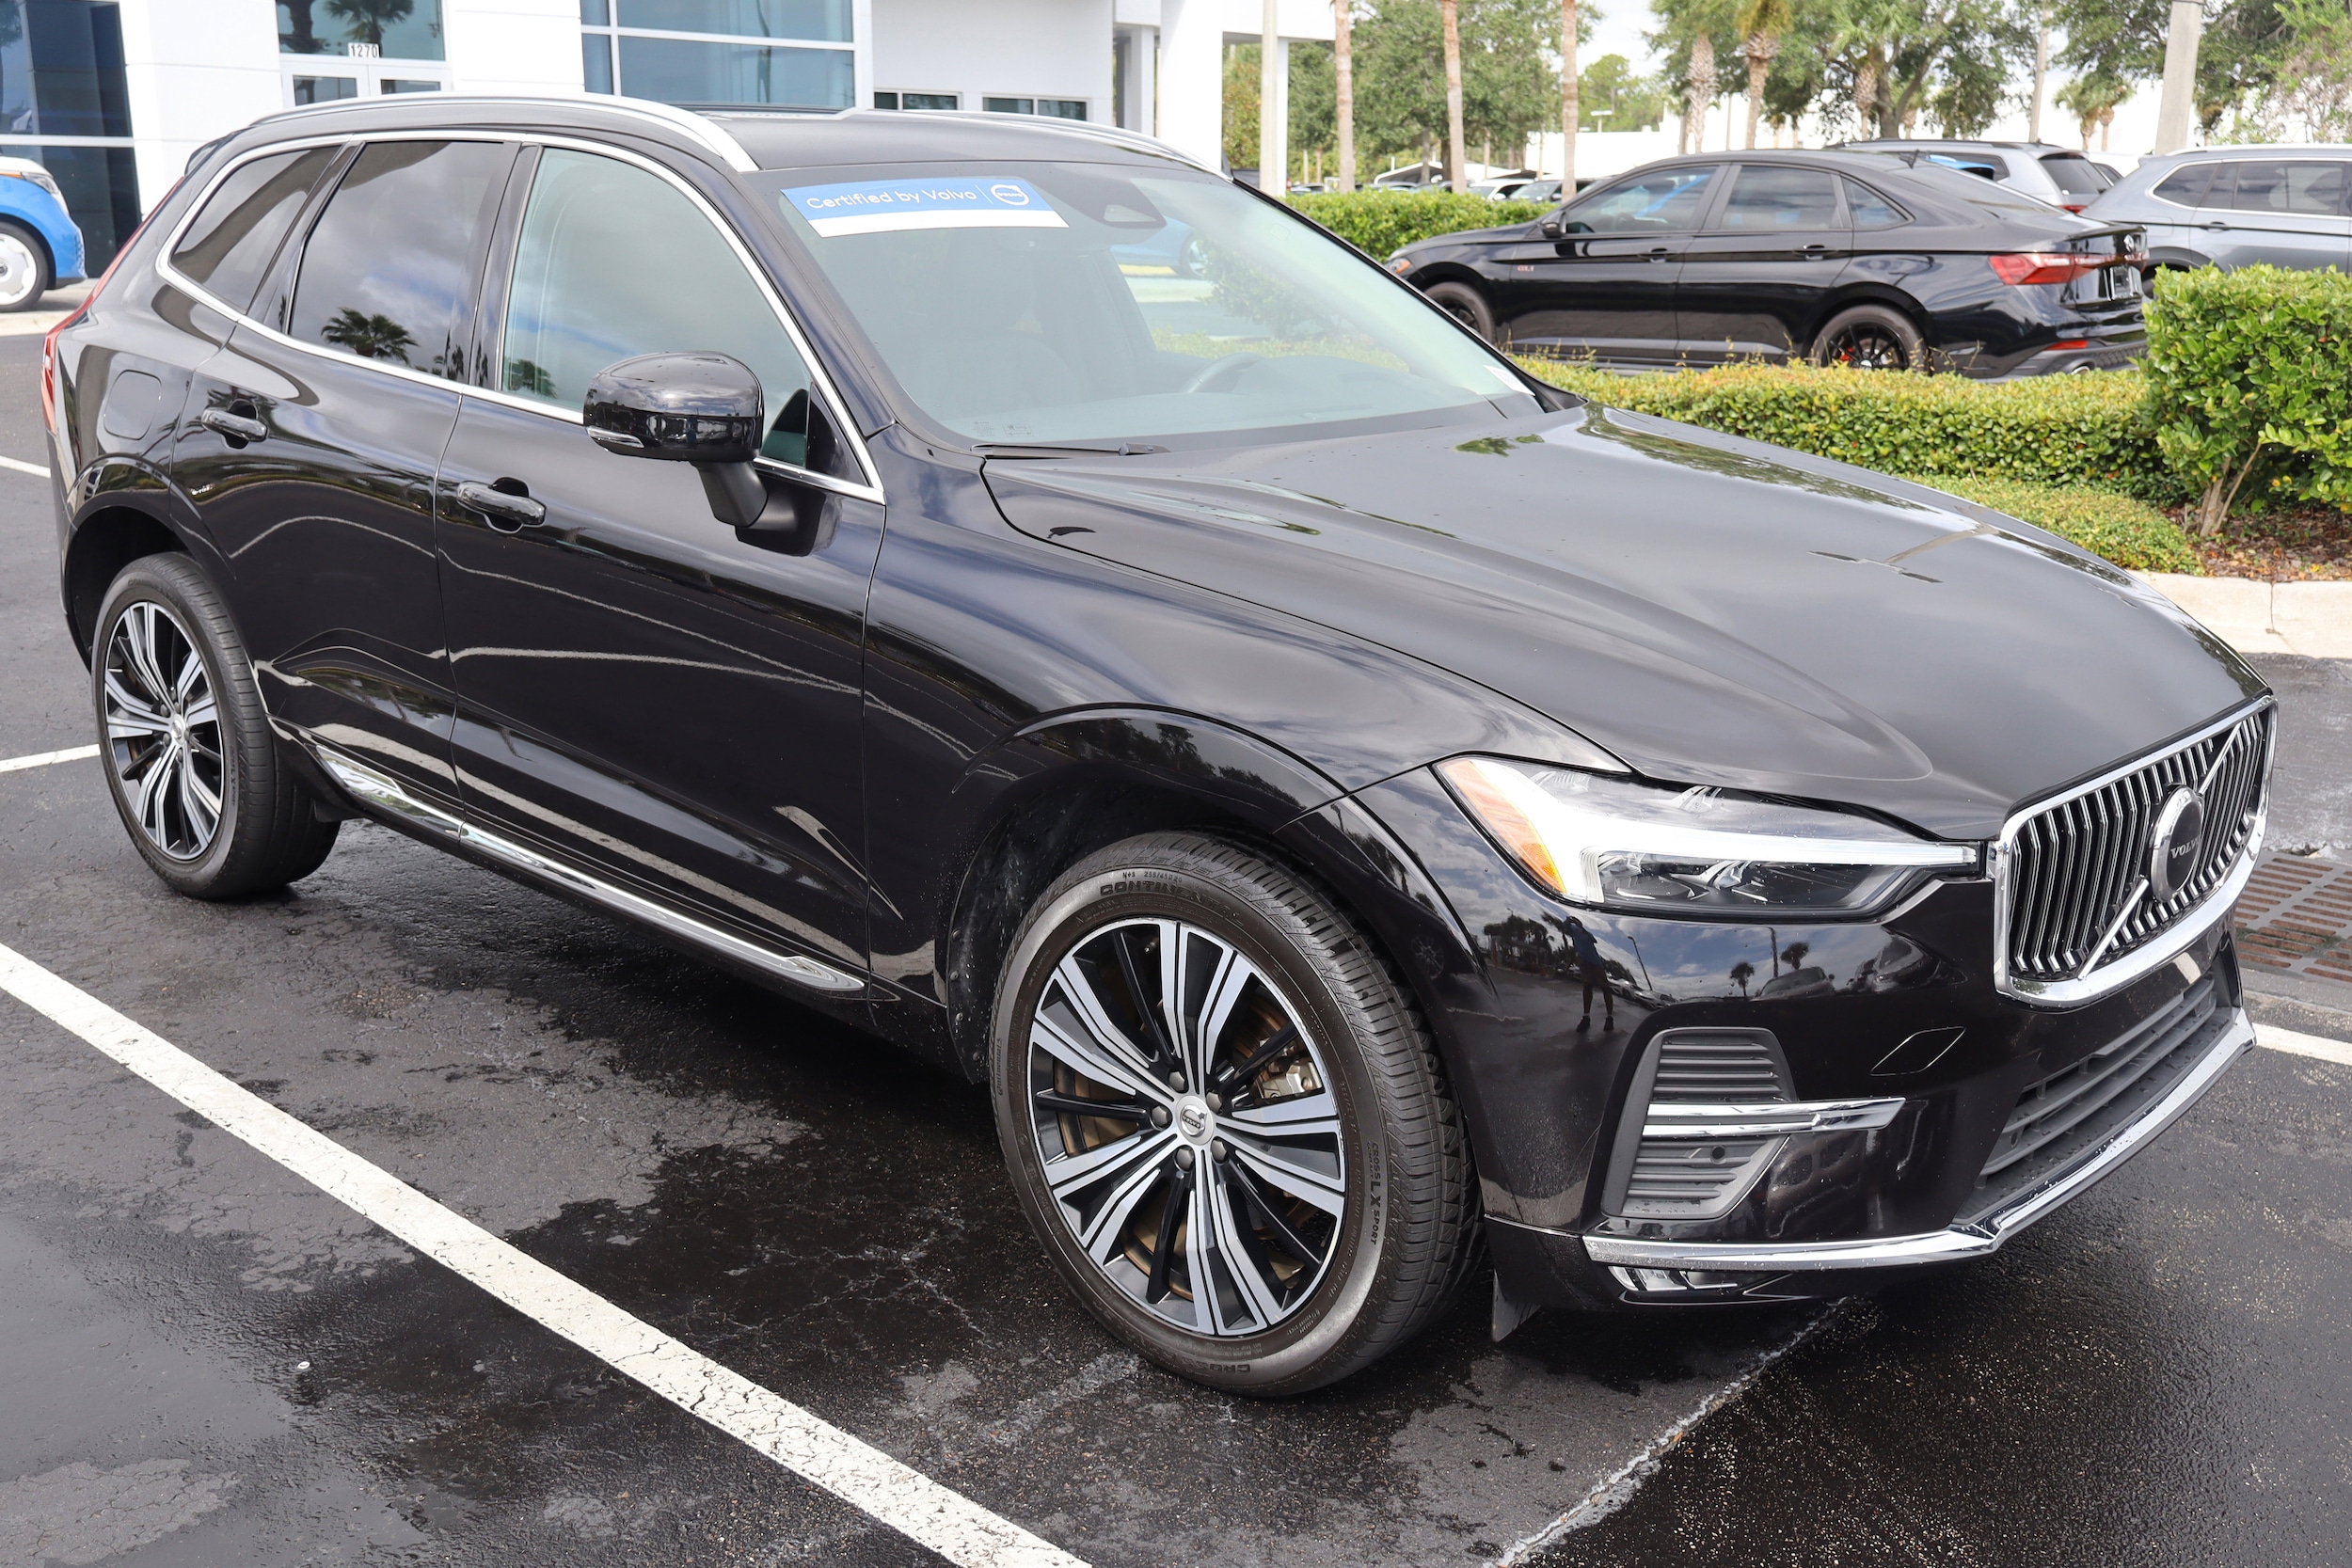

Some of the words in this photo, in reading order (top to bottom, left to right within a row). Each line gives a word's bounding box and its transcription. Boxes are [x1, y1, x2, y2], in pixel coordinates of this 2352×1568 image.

[351, 44, 378, 57] 1270
[806, 190, 894, 209] Certified
[895, 190, 920, 203] by
[921, 188, 977, 201] Volvo
[1372, 1142, 1381, 1180] CROSS
[1370, 1210, 1380, 1245] SPORT
